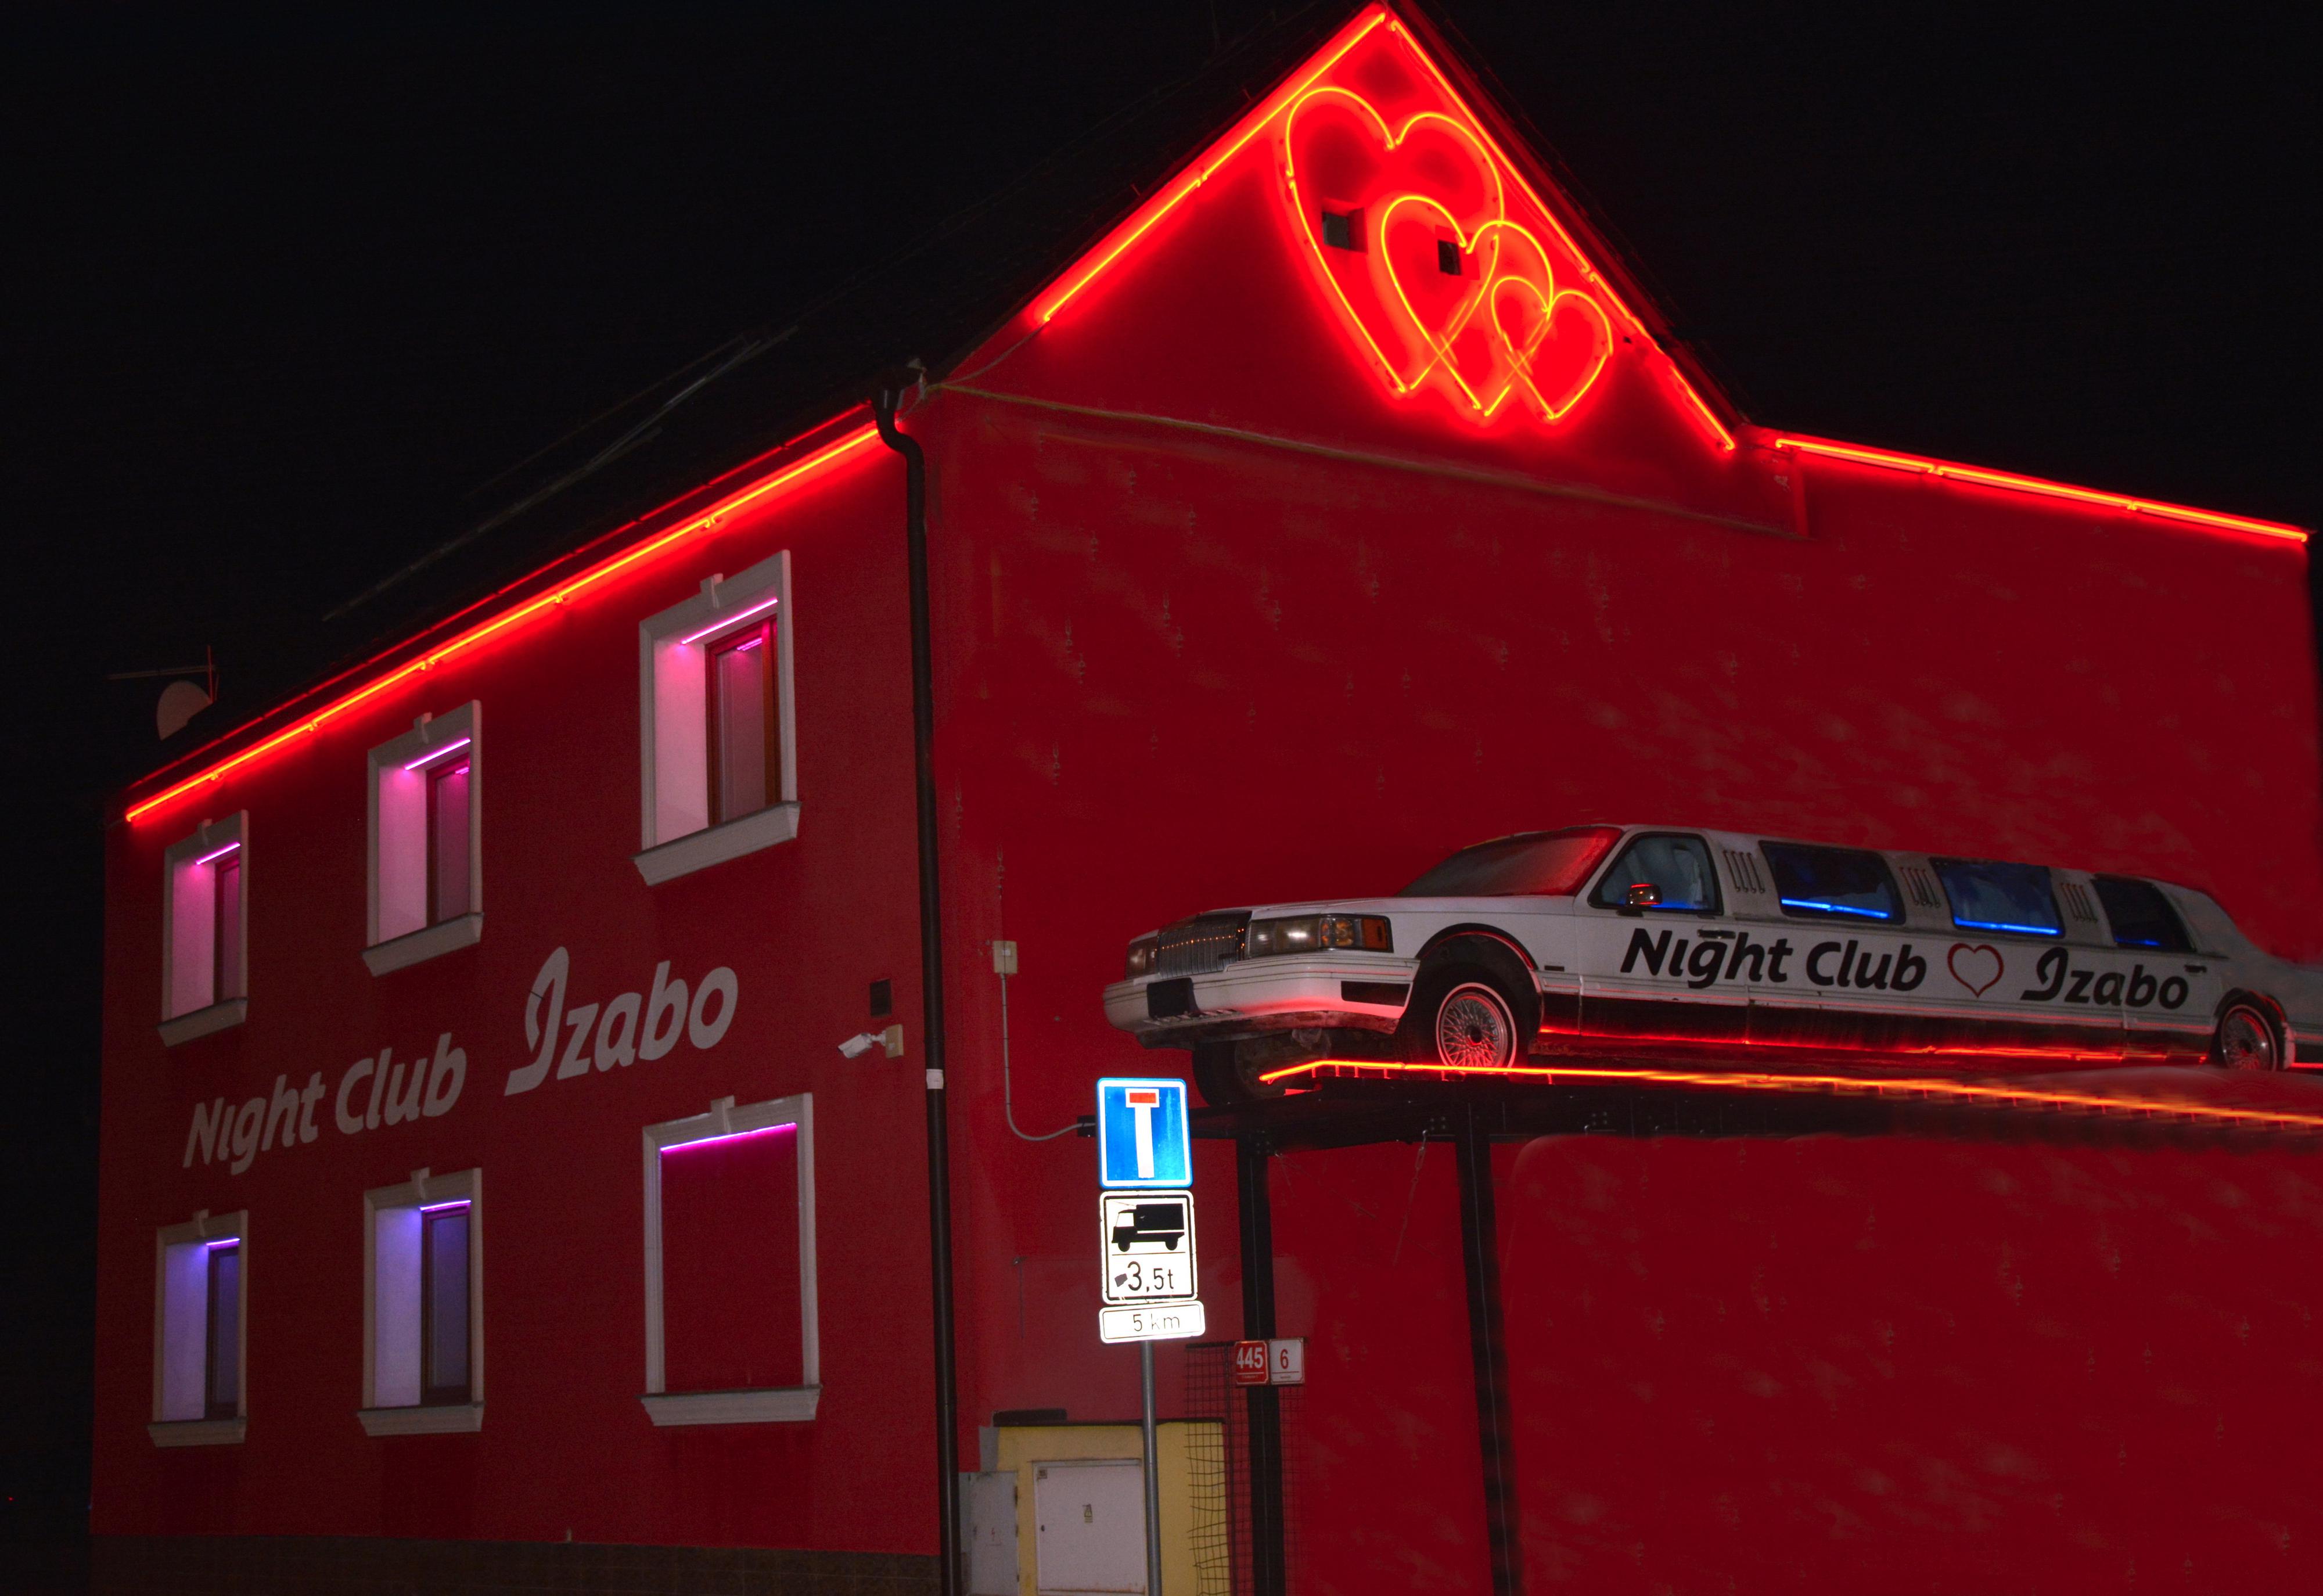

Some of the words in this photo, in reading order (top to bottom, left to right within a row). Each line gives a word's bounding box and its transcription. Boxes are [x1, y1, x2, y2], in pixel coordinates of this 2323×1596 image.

[1620, 928, 1793, 989] Night
[1806, 940, 1927, 991] Club
[2020, 947, 2189, 1010] Izabo
[182, 1071, 326, 1176] Night
[335, 1031, 466, 1135] Club
[504, 946, 738, 1097] Izabo
[1133, 1314, 1142, 1332] 5
[1151, 1313, 1180, 1330] km
[1236, 1347, 1264, 1369] 445
[1280, 1349, 1289, 1369] 6
